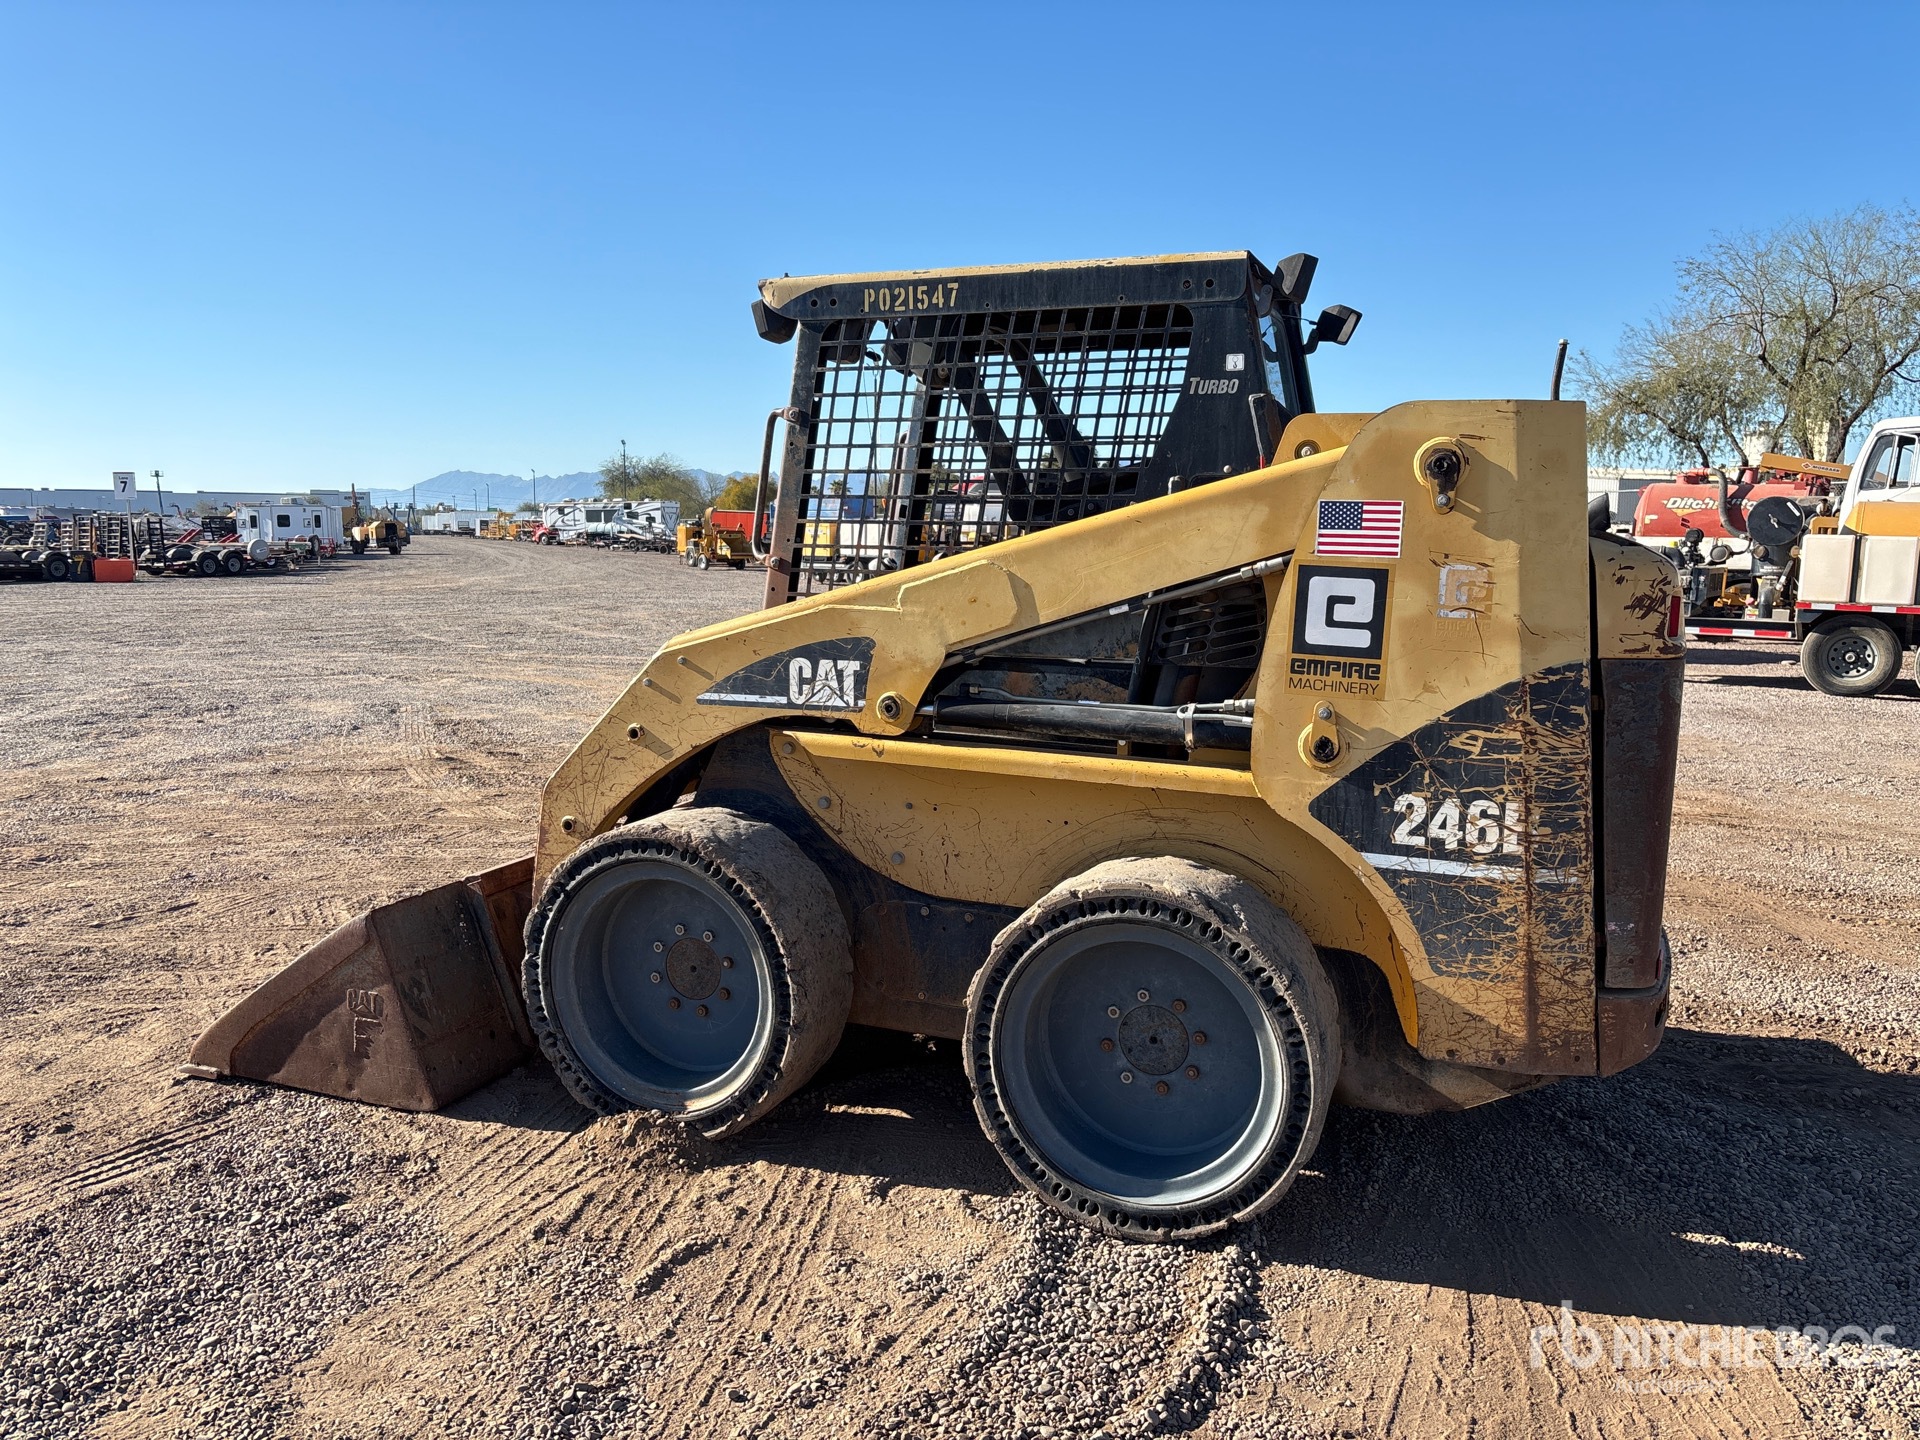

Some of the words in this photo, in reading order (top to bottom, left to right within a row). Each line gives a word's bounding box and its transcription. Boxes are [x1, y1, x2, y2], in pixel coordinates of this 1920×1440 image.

[864, 282, 959, 313] P021547
[119, 480, 128, 493] 7
[1665, 497, 1715, 509] Ditch
[73, 558, 84, 575] 7
[789, 657, 860, 707] CAT
[1288, 676, 1380, 696] MACHINERY
[346, 988, 379, 1014] CAT
